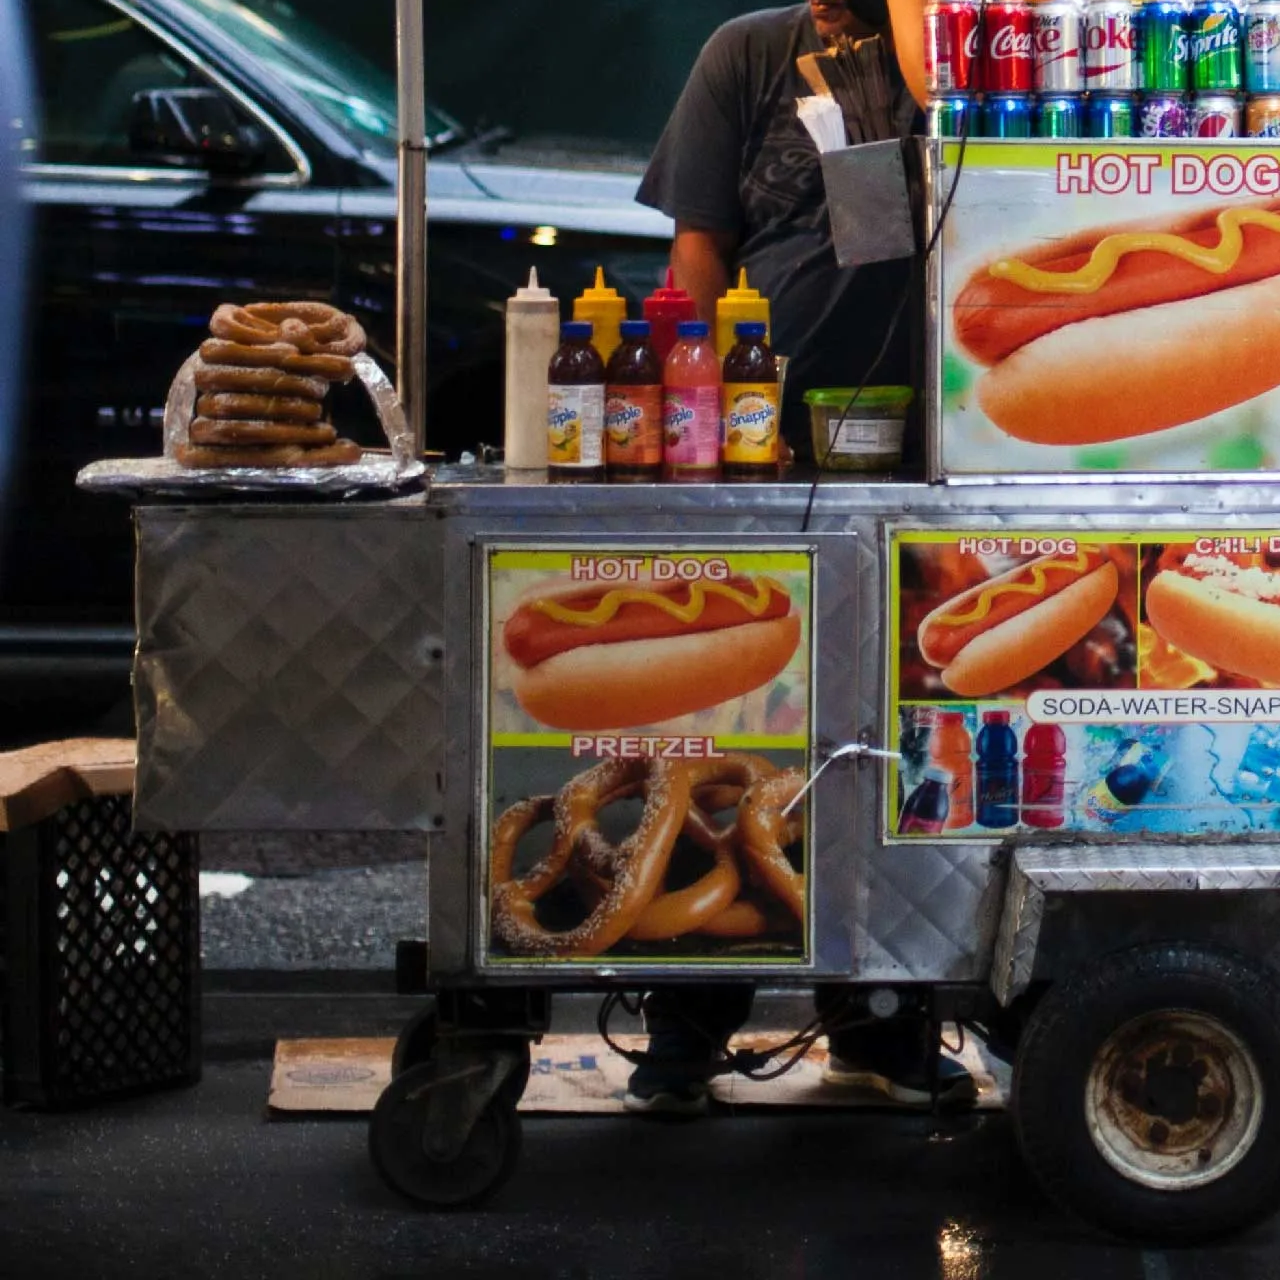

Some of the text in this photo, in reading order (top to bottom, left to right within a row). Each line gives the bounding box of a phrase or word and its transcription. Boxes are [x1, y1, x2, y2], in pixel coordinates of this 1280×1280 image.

[1057, 154, 1163, 195] HOT
[729, 403, 777, 427] Snapple
[958, 537, 1078, 555] HOT DOG
[1195, 536, 1262, 554] CHILI
[571, 558, 731, 582] HOT DOG
[571, 735, 727, 759] PRETZEL
